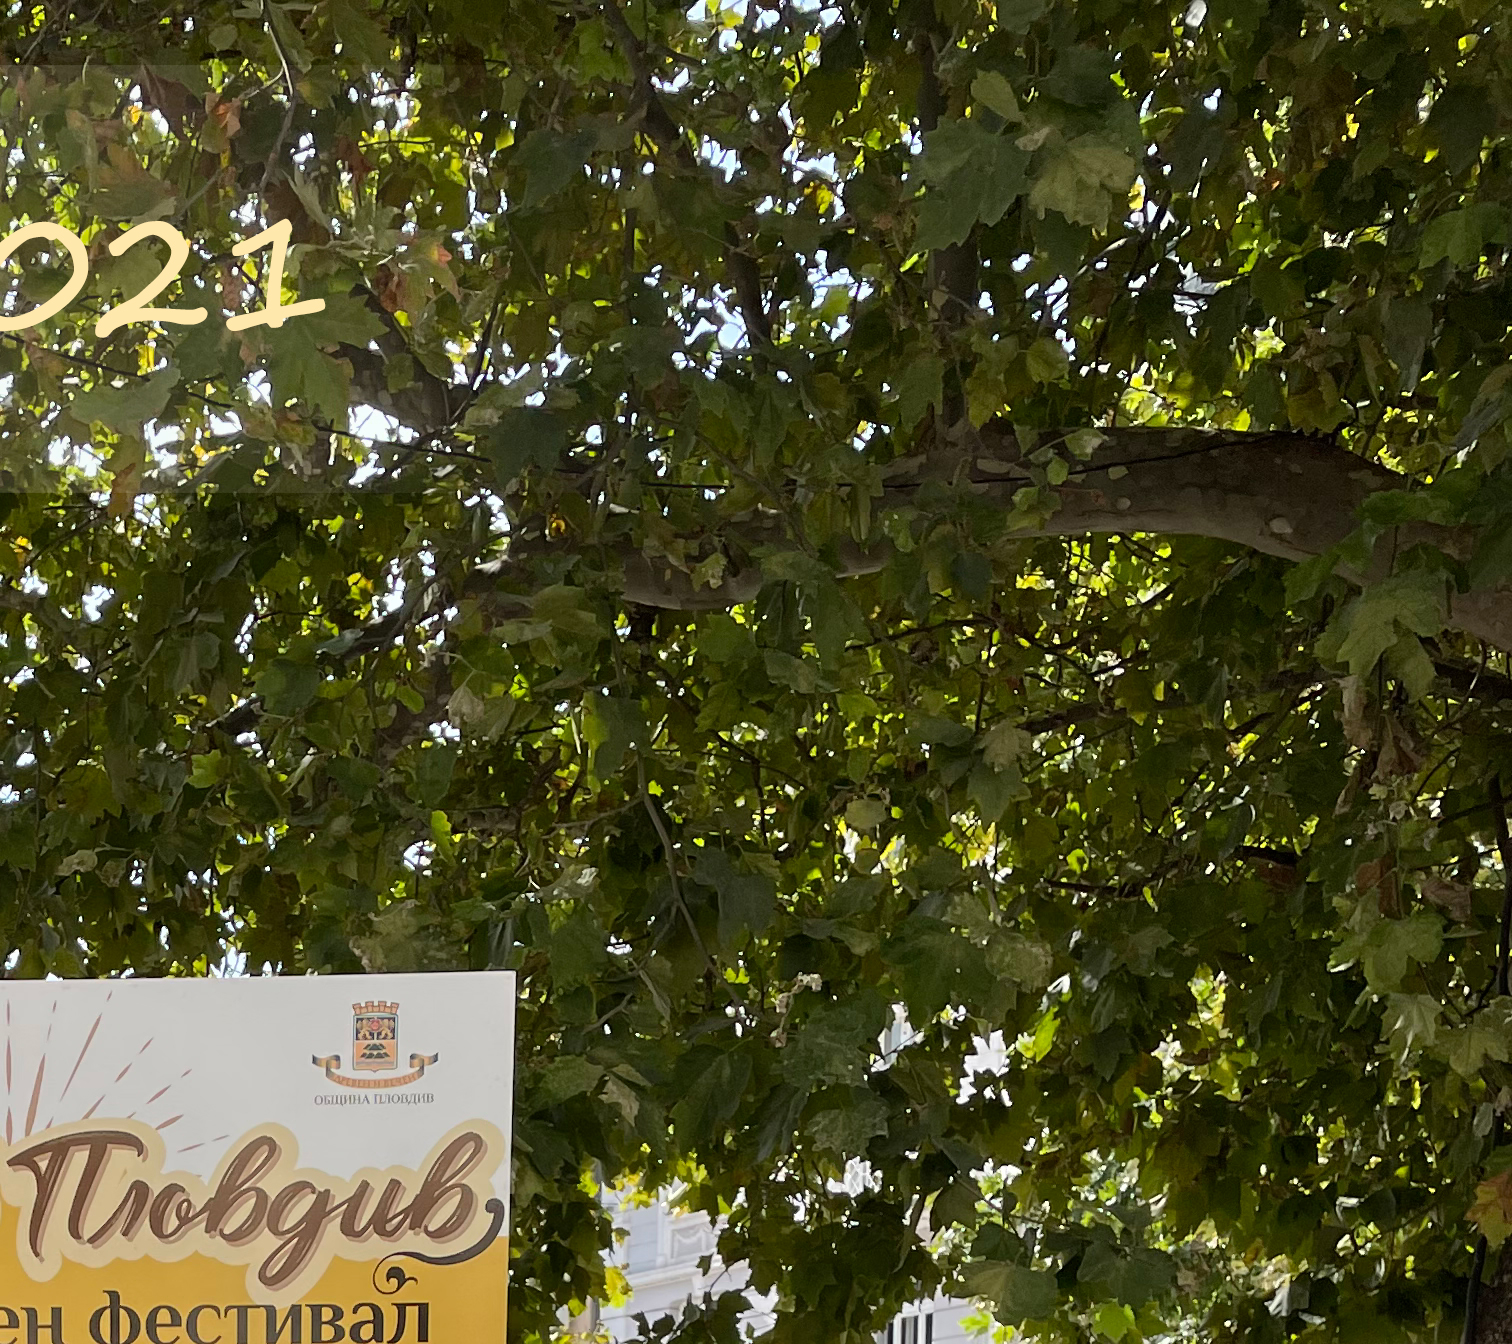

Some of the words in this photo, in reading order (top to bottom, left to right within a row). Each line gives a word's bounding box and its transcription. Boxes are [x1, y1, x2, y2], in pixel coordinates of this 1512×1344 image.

[314, 1094, 370, 1107] ОБЩИНА
[373, 1093, 435, 1106] ПЛОВДИВ
[7, 1130, 491, 1288] Пловдив
